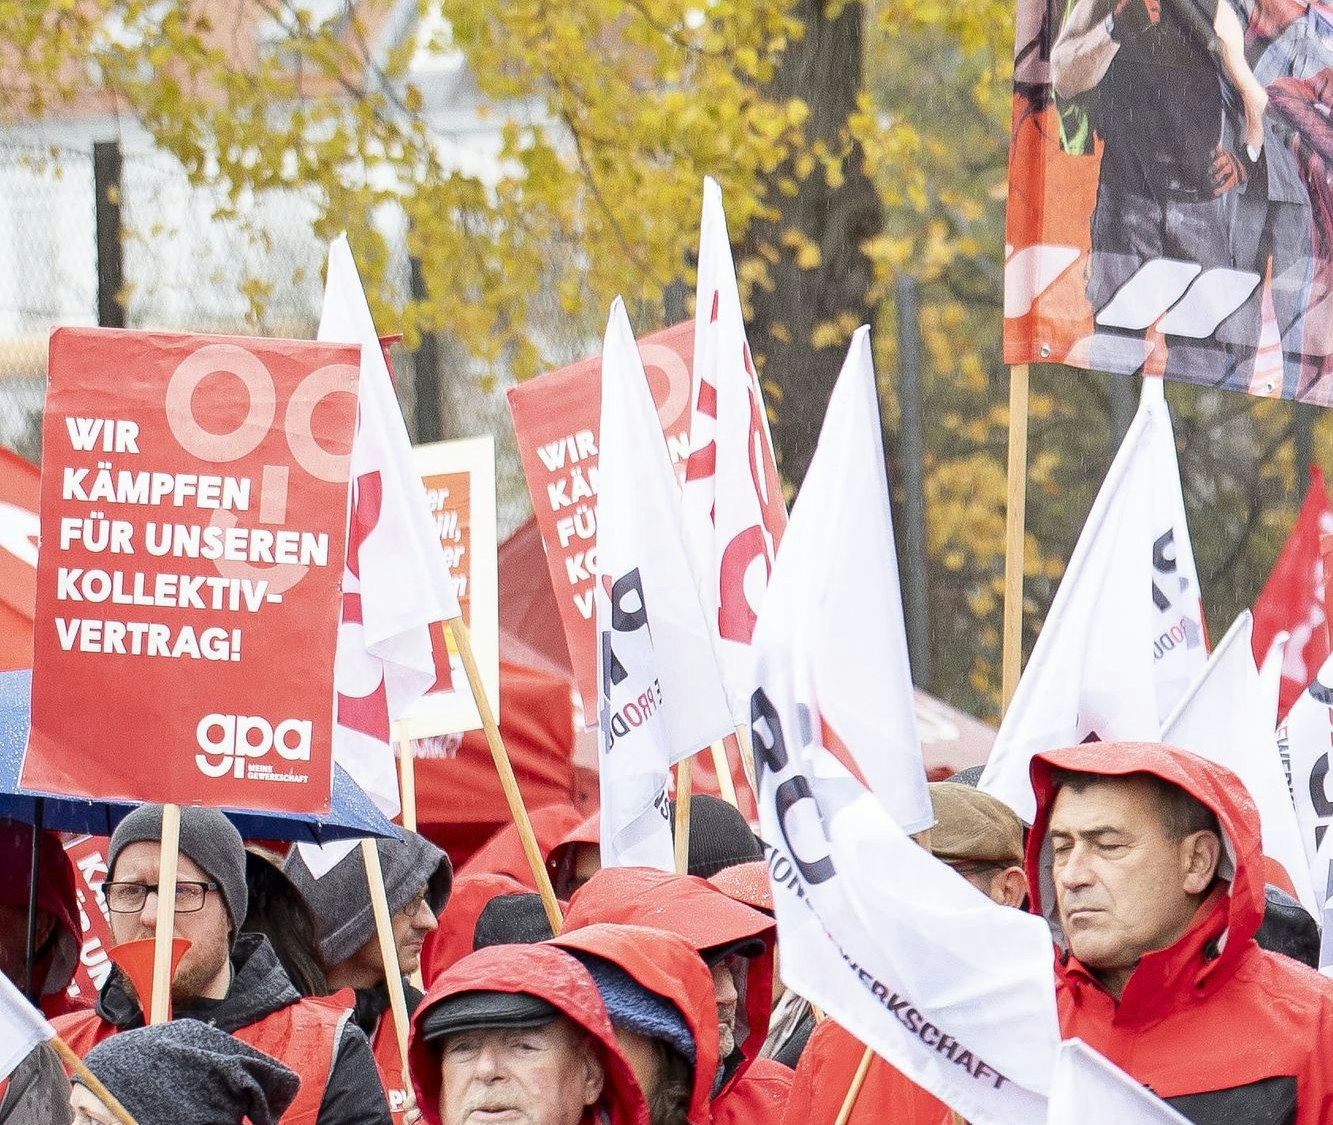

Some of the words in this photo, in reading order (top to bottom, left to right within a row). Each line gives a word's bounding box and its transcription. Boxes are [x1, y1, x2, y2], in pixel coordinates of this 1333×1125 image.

[65, 417, 140, 454] WIR
[62, 461, 251, 511] KÄMPFEN
[59, 511, 135, 554] FÜR
[145, 522, 329, 567] UNSEREN
[56, 567, 283, 613] KOLLEKTIV-
[54, 617, 242, 662] VERTRAG!
[195, 713, 313, 779] gpa
